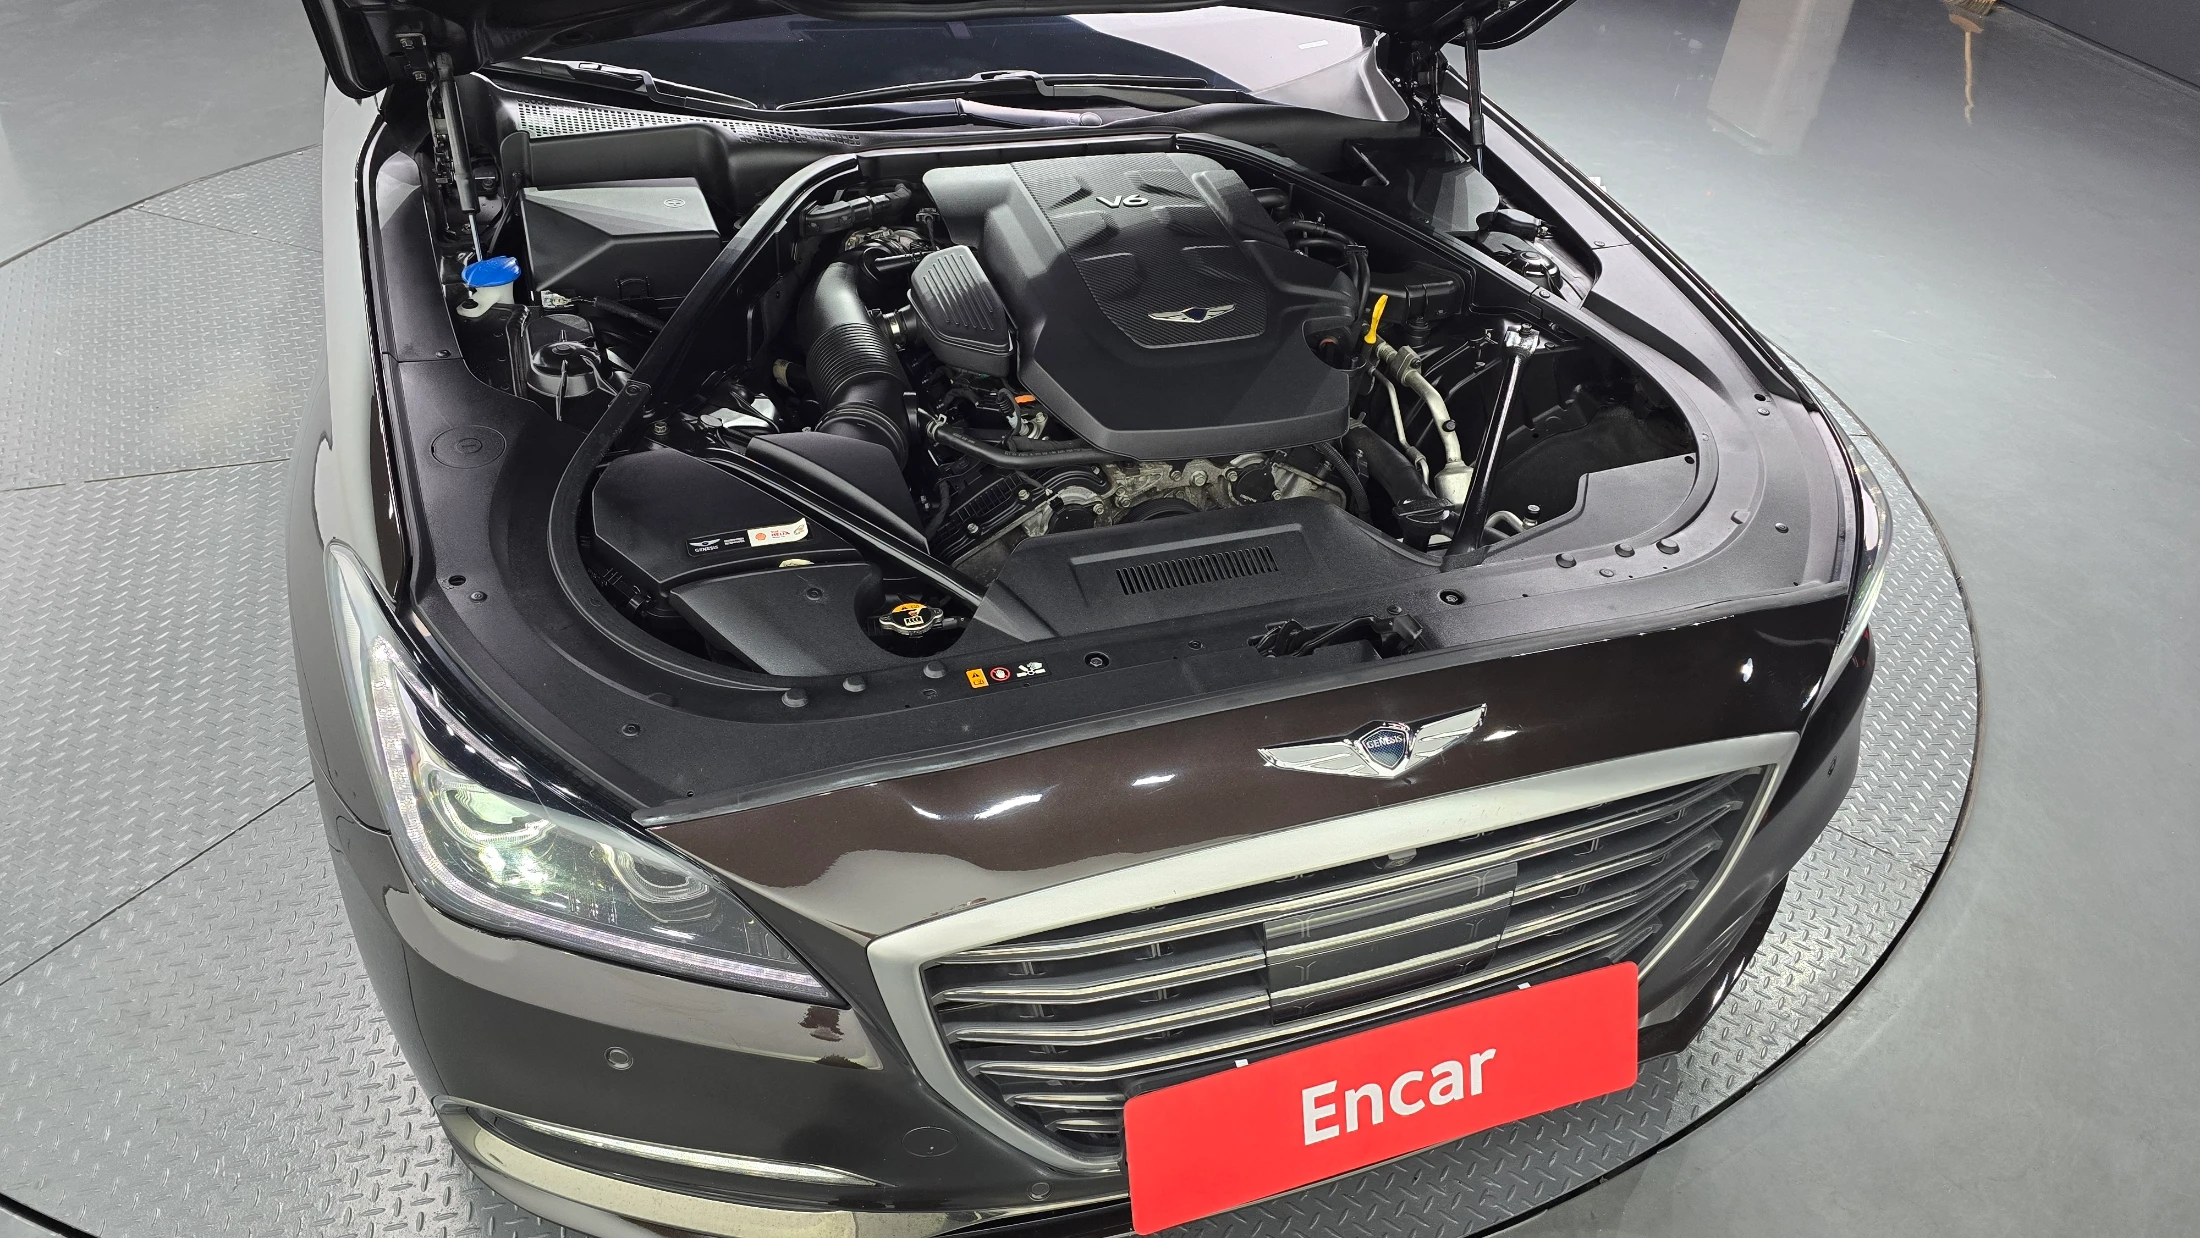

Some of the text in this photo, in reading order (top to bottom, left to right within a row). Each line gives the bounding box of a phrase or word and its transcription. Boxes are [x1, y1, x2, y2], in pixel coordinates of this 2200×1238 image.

[1096, 194, 1148, 208] V6
[1366, 735, 1403, 749] GENESIS
[1302, 1048, 1496, 1146] Encar
